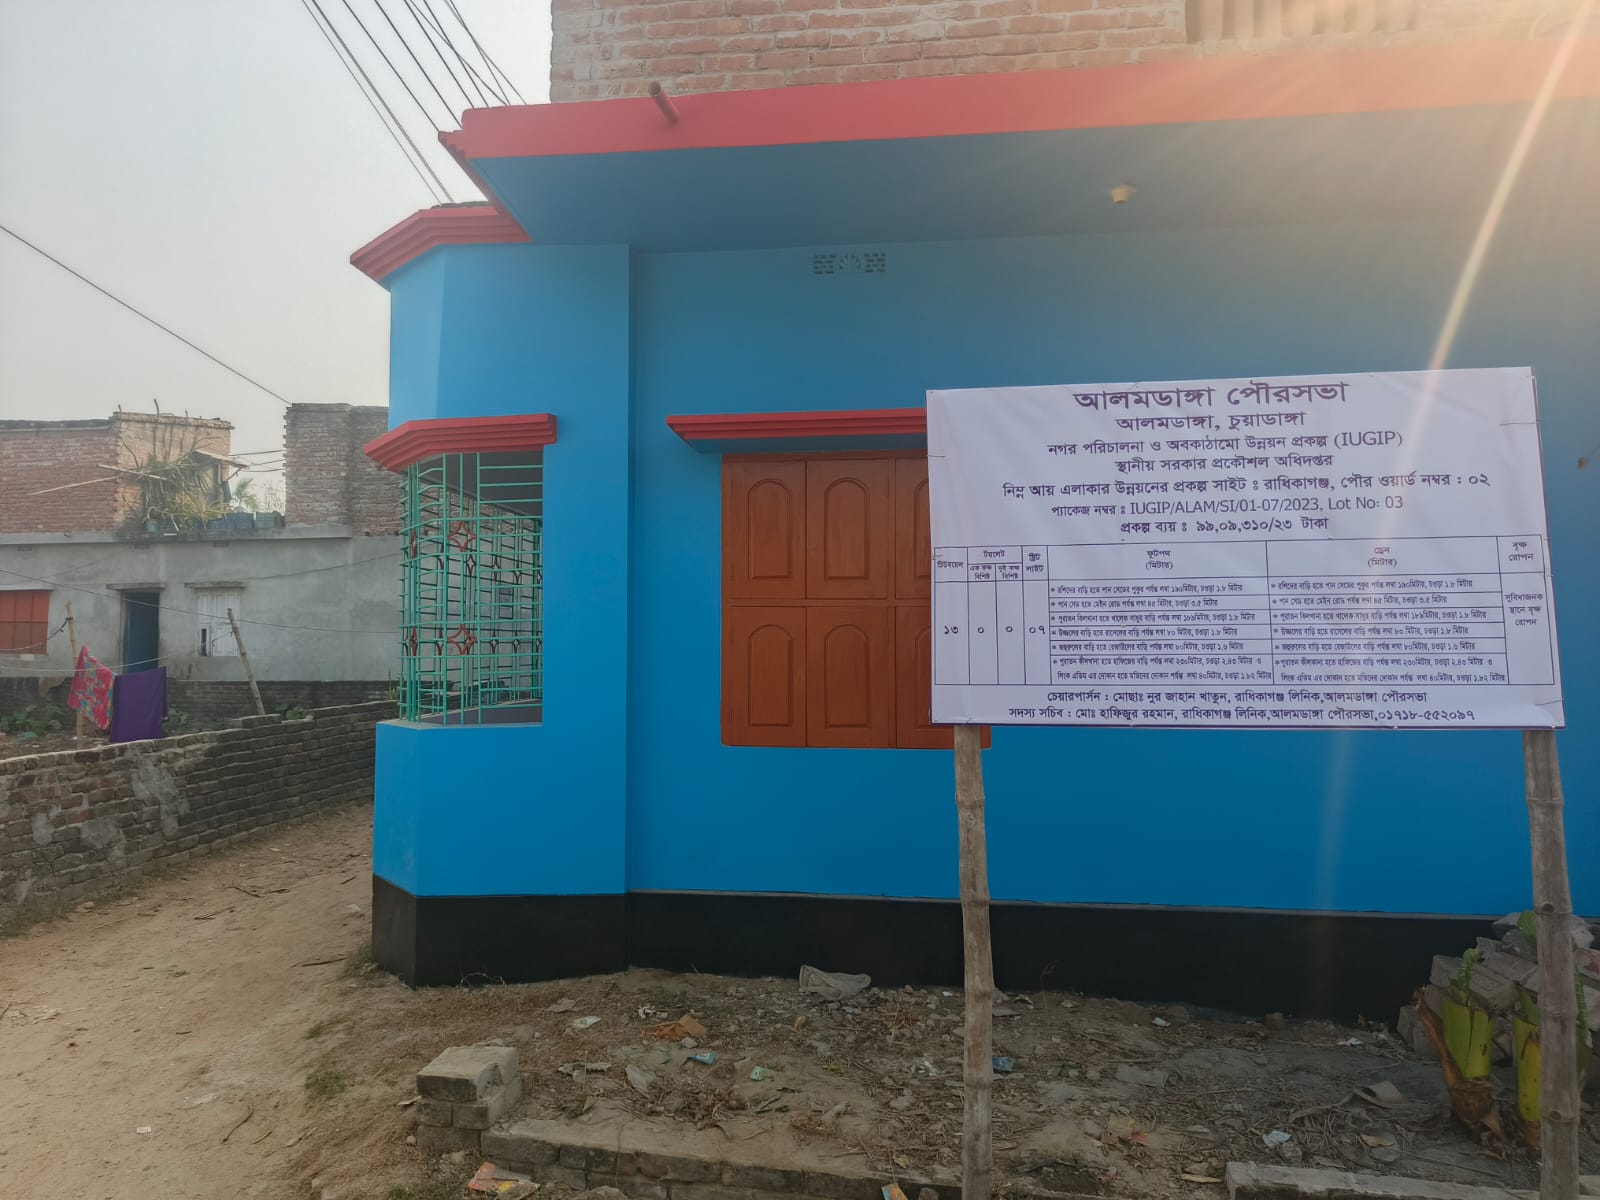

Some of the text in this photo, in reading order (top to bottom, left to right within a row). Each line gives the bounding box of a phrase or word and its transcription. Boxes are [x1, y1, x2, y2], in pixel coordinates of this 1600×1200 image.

[1072, 380, 1350, 410] আলমডাঙ্গা পৌরসভা
[1116, 411, 1306, 432] আলমডাঙ্গা, চুয়াডাঙ্গা
[1048, 431, 1403, 456] নগর পরিচালনা ও অবকাঠামো উন্নয়ন প্রকল্প (IUGIP)
[1114, 452, 1334, 474] স্থানীয় সরকার প্রকৌশল অধিদপ্তর
[1029, 484, 1055, 497] আয়
[1060, 482, 1109, 496] এলাকার
[1114, 480, 1168, 496] উন্নয়নের
[1173, 480, 1208, 494] প্রকল্প
[1212, 477, 1247, 492] সাইট
[1262, 476, 1336, 491] রাধিকাগঞ্জ,
[1341, 473, 1372, 489] পৌর
[1379, 471, 1417, 487] ওয়ার্ড
[1421, 473, 1451, 486] নম্বর
[1468, 474, 1490, 487] ০২
[1051, 505, 1090, 518] প্যাকেজ
[1094, 505, 1117, 516] নম্বর
[1328, 496, 1350, 511] Lot
[1356, 496, 1380, 510] No:
[1385, 496, 1404, 510] 03
[1120, 521, 1150, 534] প্রকল্প
[1155, 521, 1176, 533] ব্যয়
[1300, 516, 1329, 530] টাকা
[1146, 561, 1174, 570] (মিটার)
[1368, 557, 1398, 568] (মিটার)
[1508, 553, 1534, 562] রোপন
[1048, 689, 1101, 702] চেয়ারপার্সন
[1165, 692, 1196, 702] জাহান
[1234, 690, 1284, 702] রাধিকাগঞ্জ
[1382, 690, 1428, 702] পৌরসভা
[1008, 708, 1036, 719] সদস্য
[1040, 706, 1064, 719] সচিব
[1076, 708, 1096, 719] মোঃ
[1100, 707, 1138, 721] হাফিজুর
[1142, 709, 1178, 720] রহমান,
[1182, 707, 1232, 720] রাধিকাগঞ্জ
